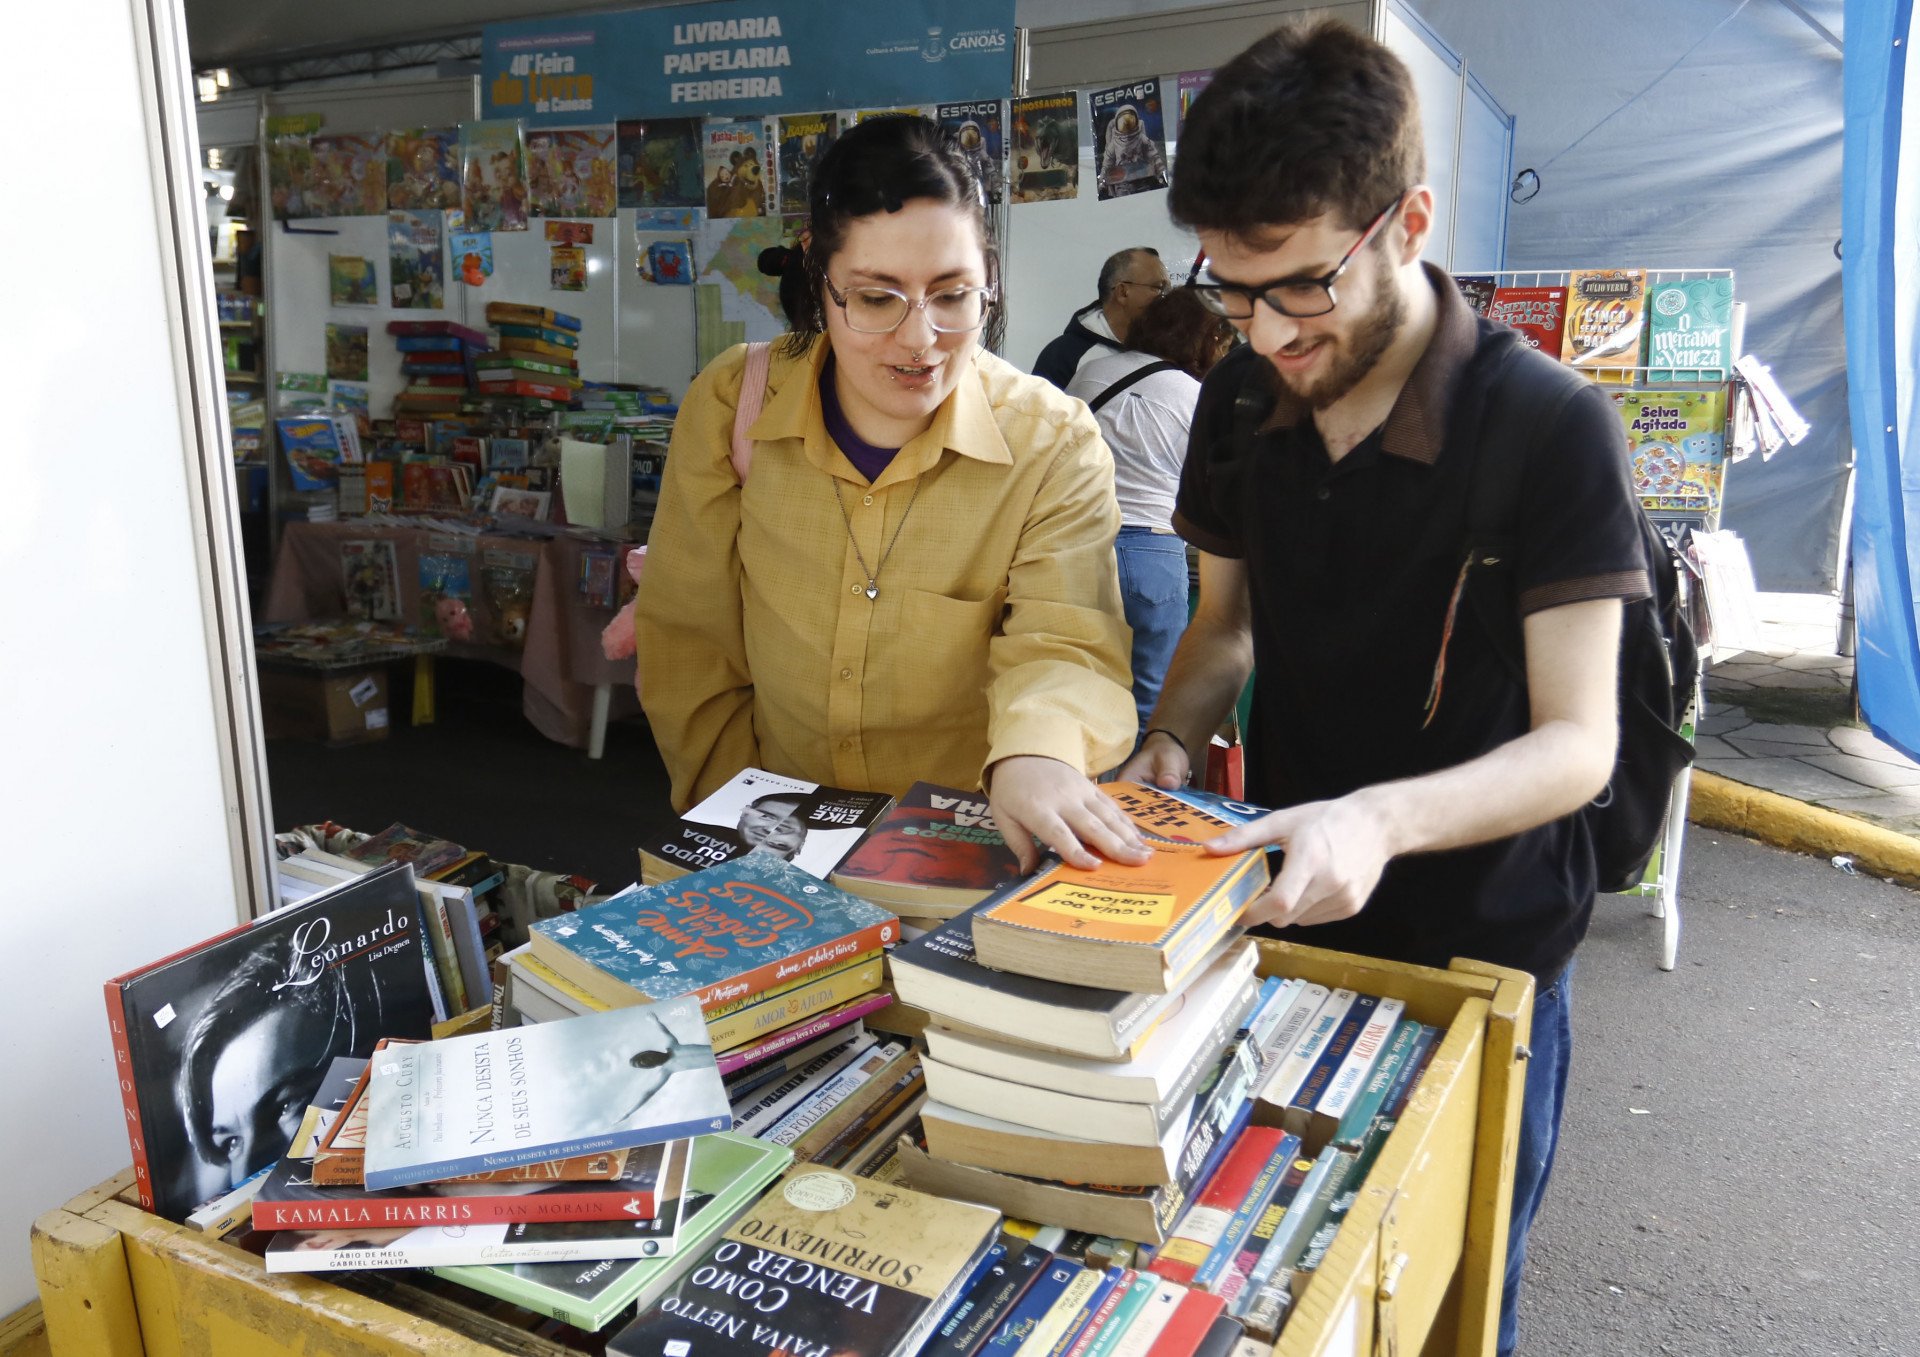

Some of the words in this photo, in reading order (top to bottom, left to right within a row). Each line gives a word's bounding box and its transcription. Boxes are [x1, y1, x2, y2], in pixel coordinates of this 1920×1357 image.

[673, 16, 782, 45] LIVRARIA
[950, 34, 1006, 50] CANOAS
[535, 52, 575, 75] Feira
[664, 45, 791, 75] PAPELARIA
[866, 47, 889, 55] Cultura
[529, 70, 593, 103] Livro
[671, 76, 783, 103] FERREIRA
[536, 98, 549, 113] de
[551, 97, 593, 112] Canoas
[940, 103, 997, 118] ESPAÇO
[1013, 97, 1073, 113] DINOSSAUROS
[787, 123, 828, 138] BATMAN
[1607, 283, 1629, 292] VERNE
[1493, 301, 1561, 318] SHERLOCK
[1498, 312, 1556, 331] HOLMES
[1584, 307, 1627, 323] CINCO
[1641, 406, 1678, 418] Selva
[1631, 419, 1687, 433] Agitada
[809, 810, 859, 826] EIKE
[818, 803, 865, 814] BATISTA
[682, 828, 738, 854] NADA
[701, 845, 727, 860] OU
[661, 844, 717, 869] TUDO
[1047, 899, 1079, 908] DOS
[1065, 890, 1159, 907] CURIOSOS
[638, 909, 729, 959] Anne
[934, 935, 973, 951] mais
[272, 909, 409, 992] Leonardo
[367, 950, 383, 964] Lisa
[383, 938, 411, 956] Degnen
[776, 963, 801, 979] Anne
[493, 984, 505, 1005] The
[754, 1006, 786, 1030] AMOR
[800, 988, 834, 1015] AJUDA
[710, 1029, 736, 1045] SANTOS
[743, 1046, 762, 1062] Santo
[785, 1035, 797, 1047] nos
[796, 1029, 809, 1043] leva
[813, 1021, 830, 1035] Cristo
[395, 1055, 413, 1087] CURY
[474, 1042, 492, 1091] DESISTA
[507, 1037, 526, 1086] SONHOS
[511, 1090, 529, 1120] SEUS
[789, 1092, 840, 1135] FOLLETT
[832, 1076, 861, 1098] U700
[394, 1094, 413, 1150] AUGUSTO
[469, 1095, 495, 1144] NUNCA
[513, 1122, 531, 1139] DE
[765, 1111, 801, 1139] SONHOS
[392, 1166, 436, 1181] AUGUSTO
[483, 1156, 516, 1167] NUNCA
[517, 1150, 547, 1162] DESISTA
[548, 1148, 560, 1156] DE
[560, 1146, 580, 1155] SEUS
[581, 1139, 614, 1151] SONHOS
[1265, 1163, 1278, 1177] DA
[1270, 1152, 1285, 1167] LUZ
[275, 1207, 371, 1225] KAMALA
[385, 1203, 473, 1221] HARRIS
[494, 1205, 530, 1217] DAN
[537, 1202, 604, 1216] MORAIN
[1251, 1199, 1289, 1244] ESFINGE
[329, 1260, 368, 1268] GABRIEL
[371, 1258, 410, 1267] CHALITA
[333, 1252, 361, 1260] FÁBIO
[364, 1251, 377, 1259] DE
[380, 1250, 405, 1259] MELO
[714, 1242, 742, 1263] O
[739, 1218, 923, 1288] SOFRIMENTO
[692, 1266, 790, 1314] COMO
[747, 1249, 880, 1315] VENCER
[660, 1297, 747, 1339] NETTO
[941, 1317, 961, 1339] CATHY
[954, 1299, 976, 1322] HAPKA
[953, 1328, 976, 1353] Sobre
[968, 1304, 996, 1336] formigas
[992, 1278, 1018, 1307] cigarras
[1075, 1324, 1099, 1351] MUNDO
[1097, 1314, 1123, 1343] trabalho
[752, 1326, 832, 1357] PAIVA
